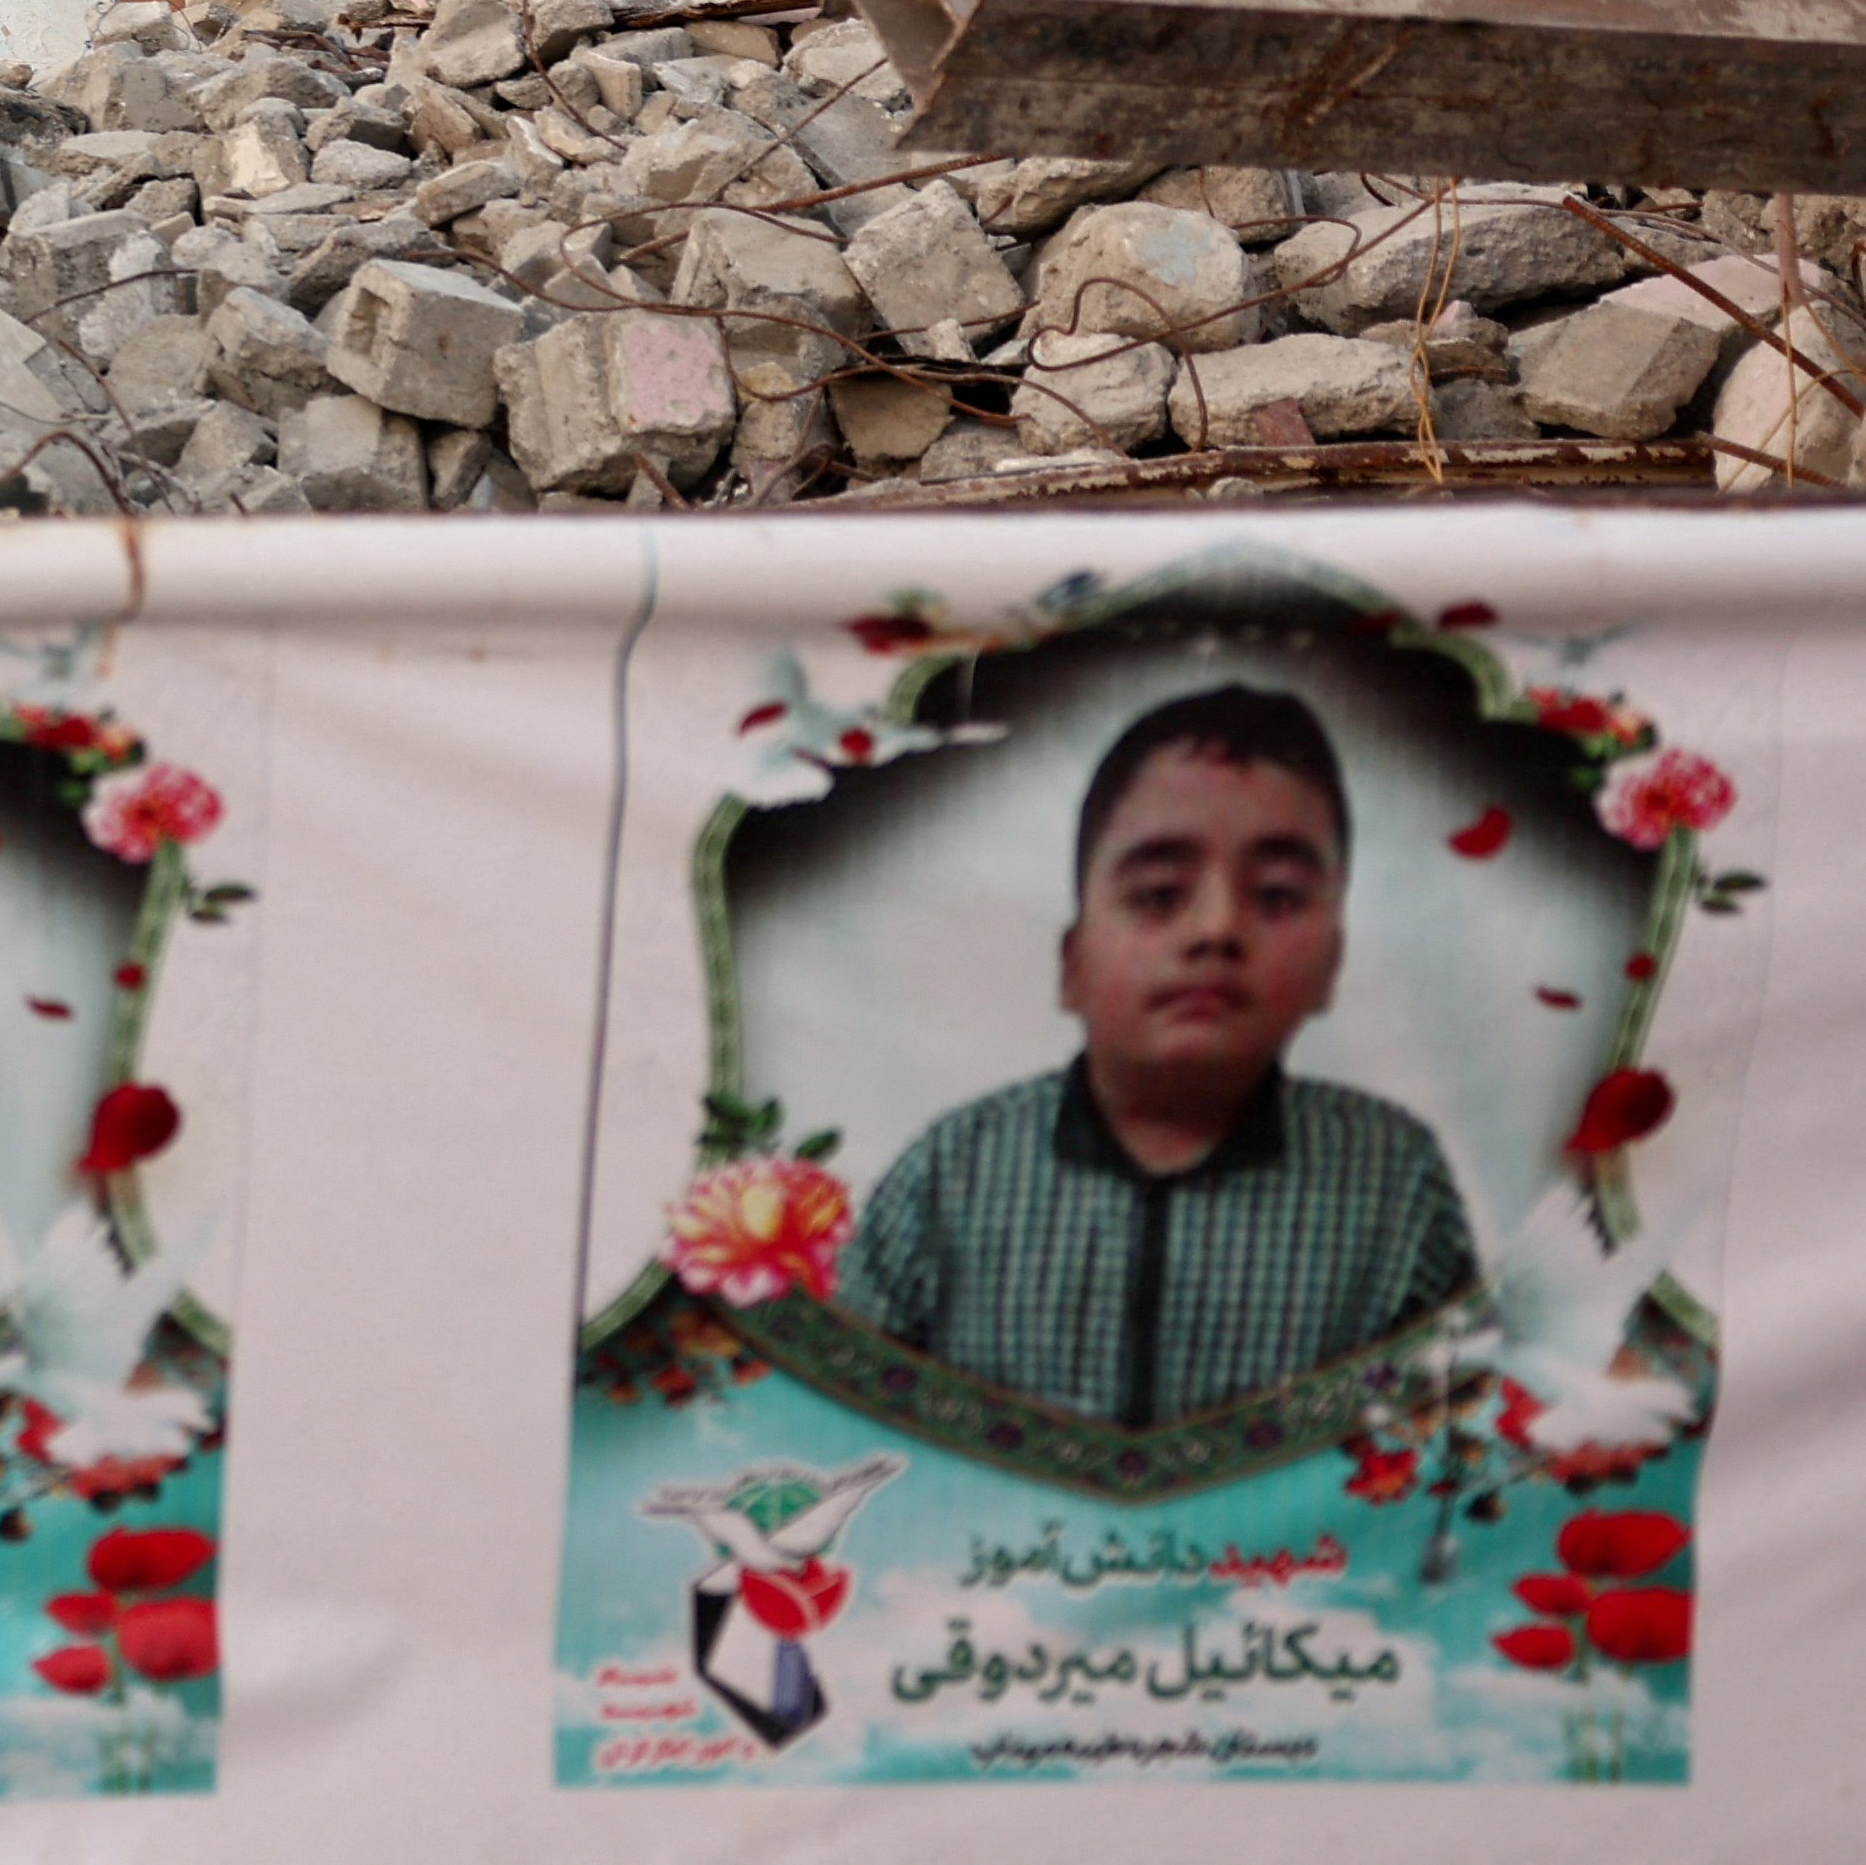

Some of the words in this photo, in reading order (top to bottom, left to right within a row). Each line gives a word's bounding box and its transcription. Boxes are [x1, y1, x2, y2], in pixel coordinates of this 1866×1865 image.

[1210, 1530, 1347, 1588] شهید
[890, 1617, 1136, 1705] میردوقی
[1146, 1622, 1400, 1702] میکائیل
